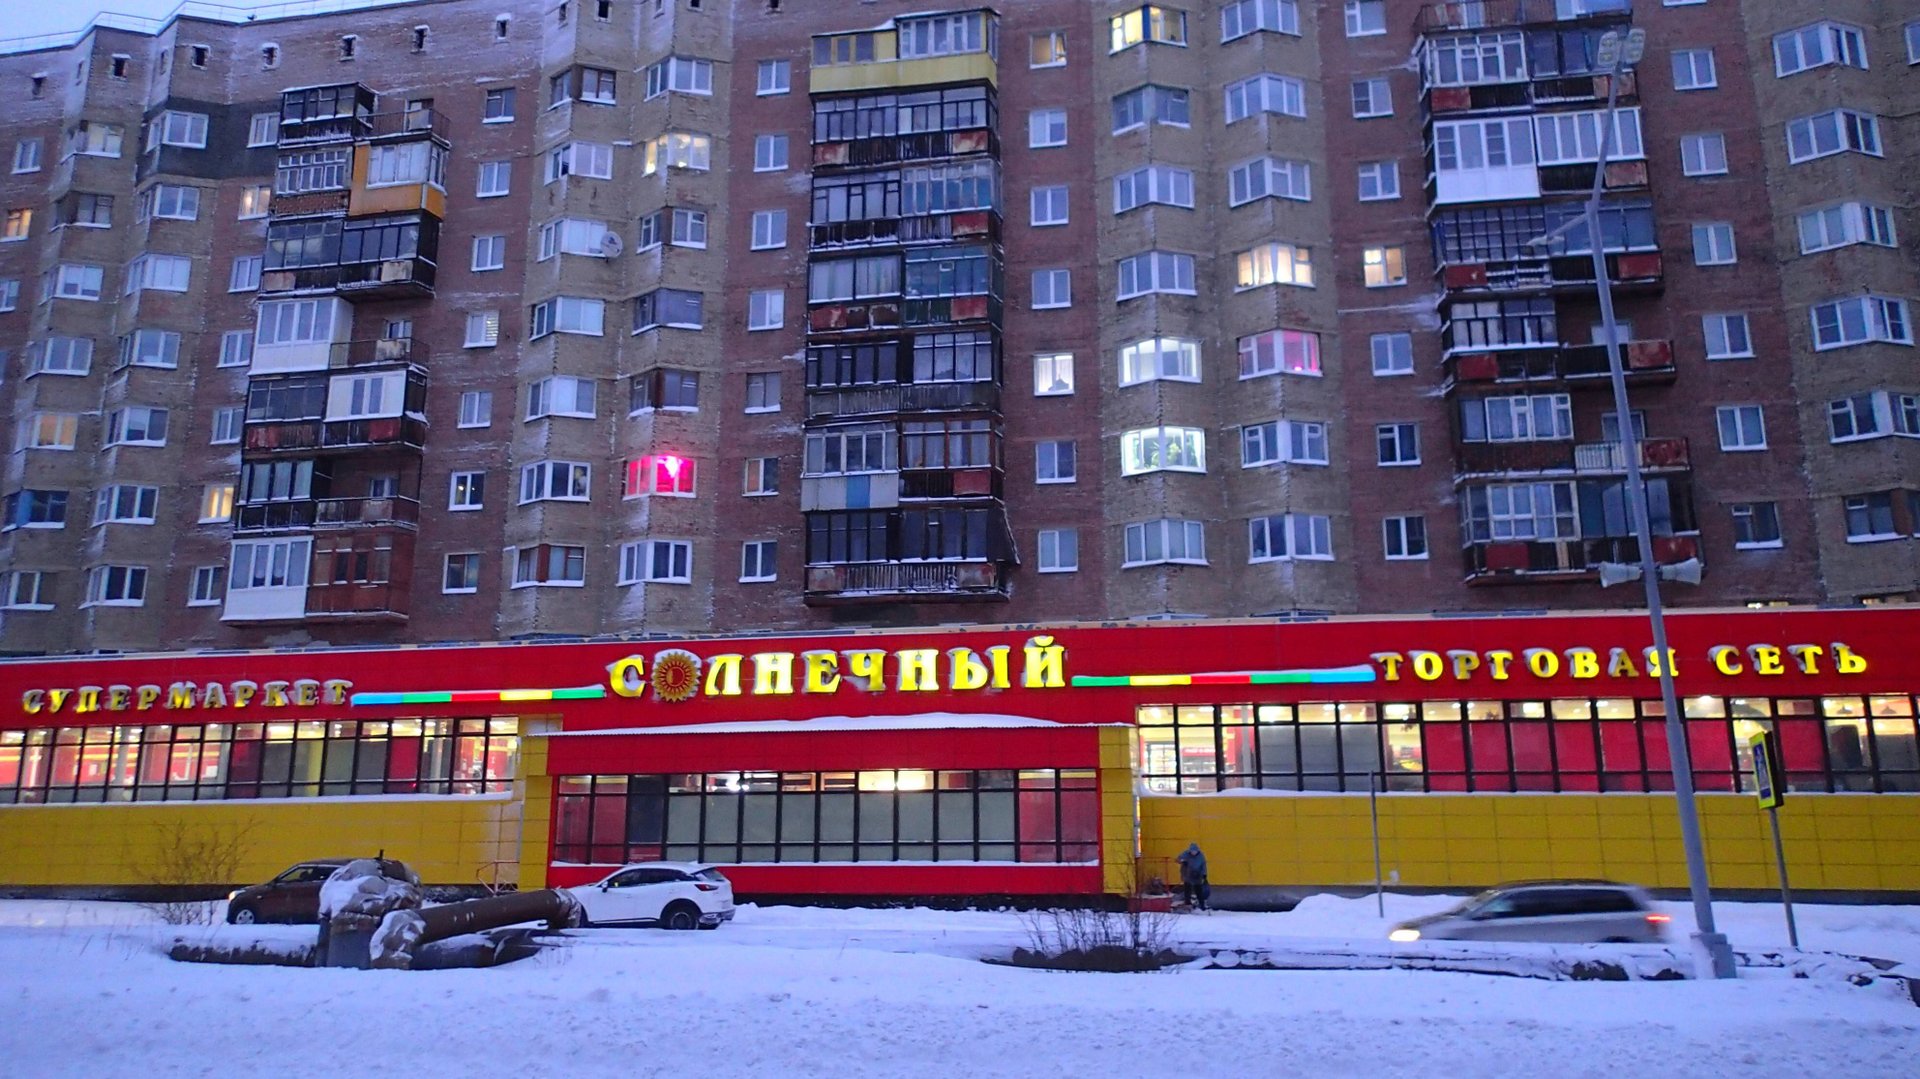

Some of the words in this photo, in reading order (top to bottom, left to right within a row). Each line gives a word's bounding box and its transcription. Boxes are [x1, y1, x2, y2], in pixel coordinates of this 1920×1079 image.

[607, 635, 1066, 702] СОЛНЕЧНЫЙ
[1374, 647, 1679, 681] ТОРГОВАЯ
[1712, 643, 1867, 675] СЕТЬ
[23, 680, 353, 714] СУПЕРМАРКЕТ
